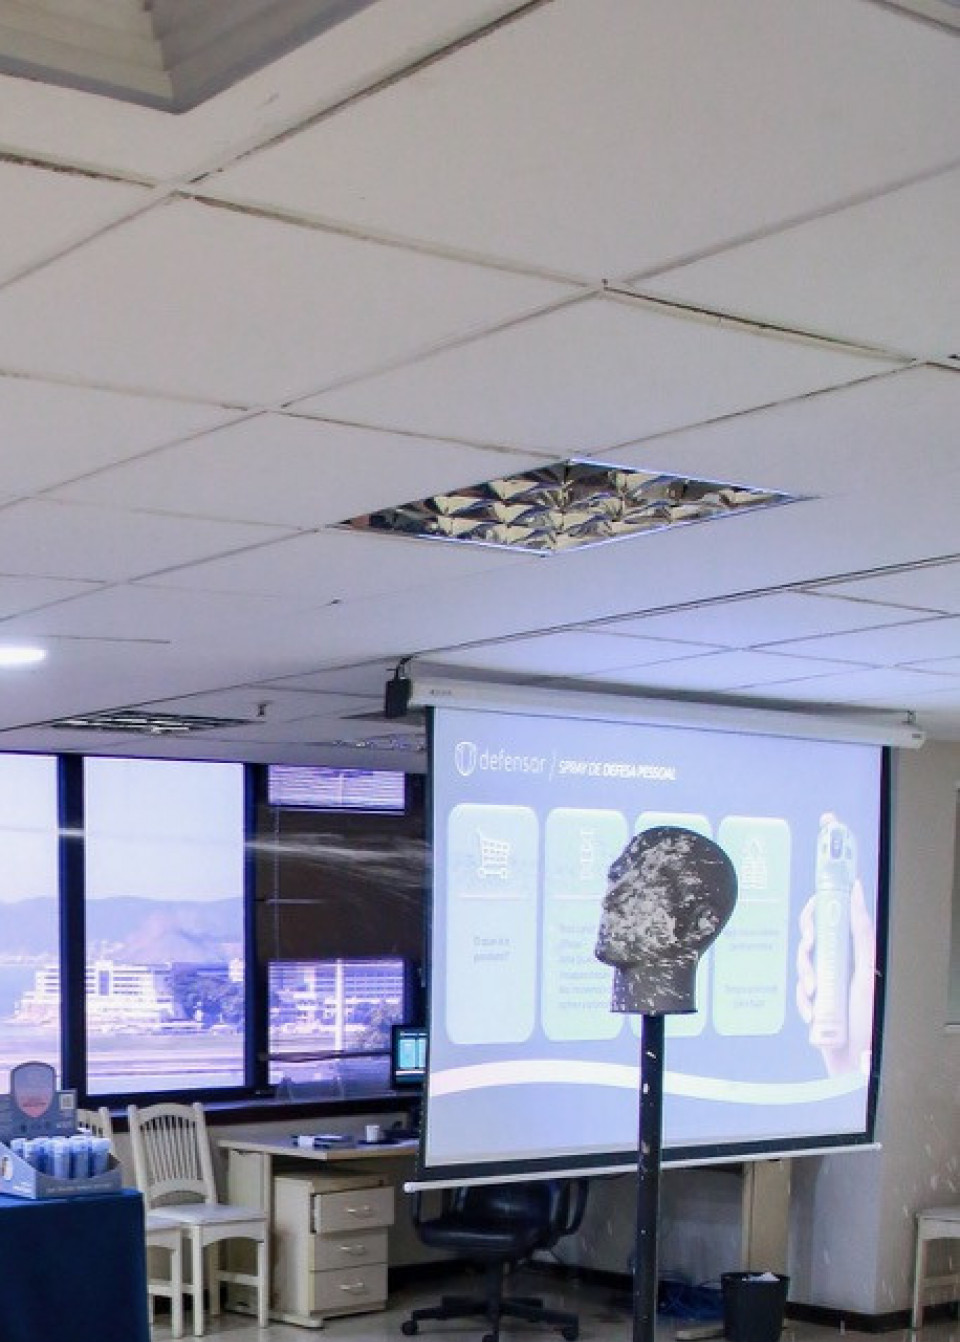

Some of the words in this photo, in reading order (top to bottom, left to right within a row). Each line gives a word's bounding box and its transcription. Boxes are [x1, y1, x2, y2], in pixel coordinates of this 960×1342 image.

[479, 748, 547, 774] defensor
[558, 760, 588, 775] SPRAY
[589, 762, 602, 777] DE
[603, 763, 636, 779] DEFESA
[639, 765, 677, 781] PESSOAL
